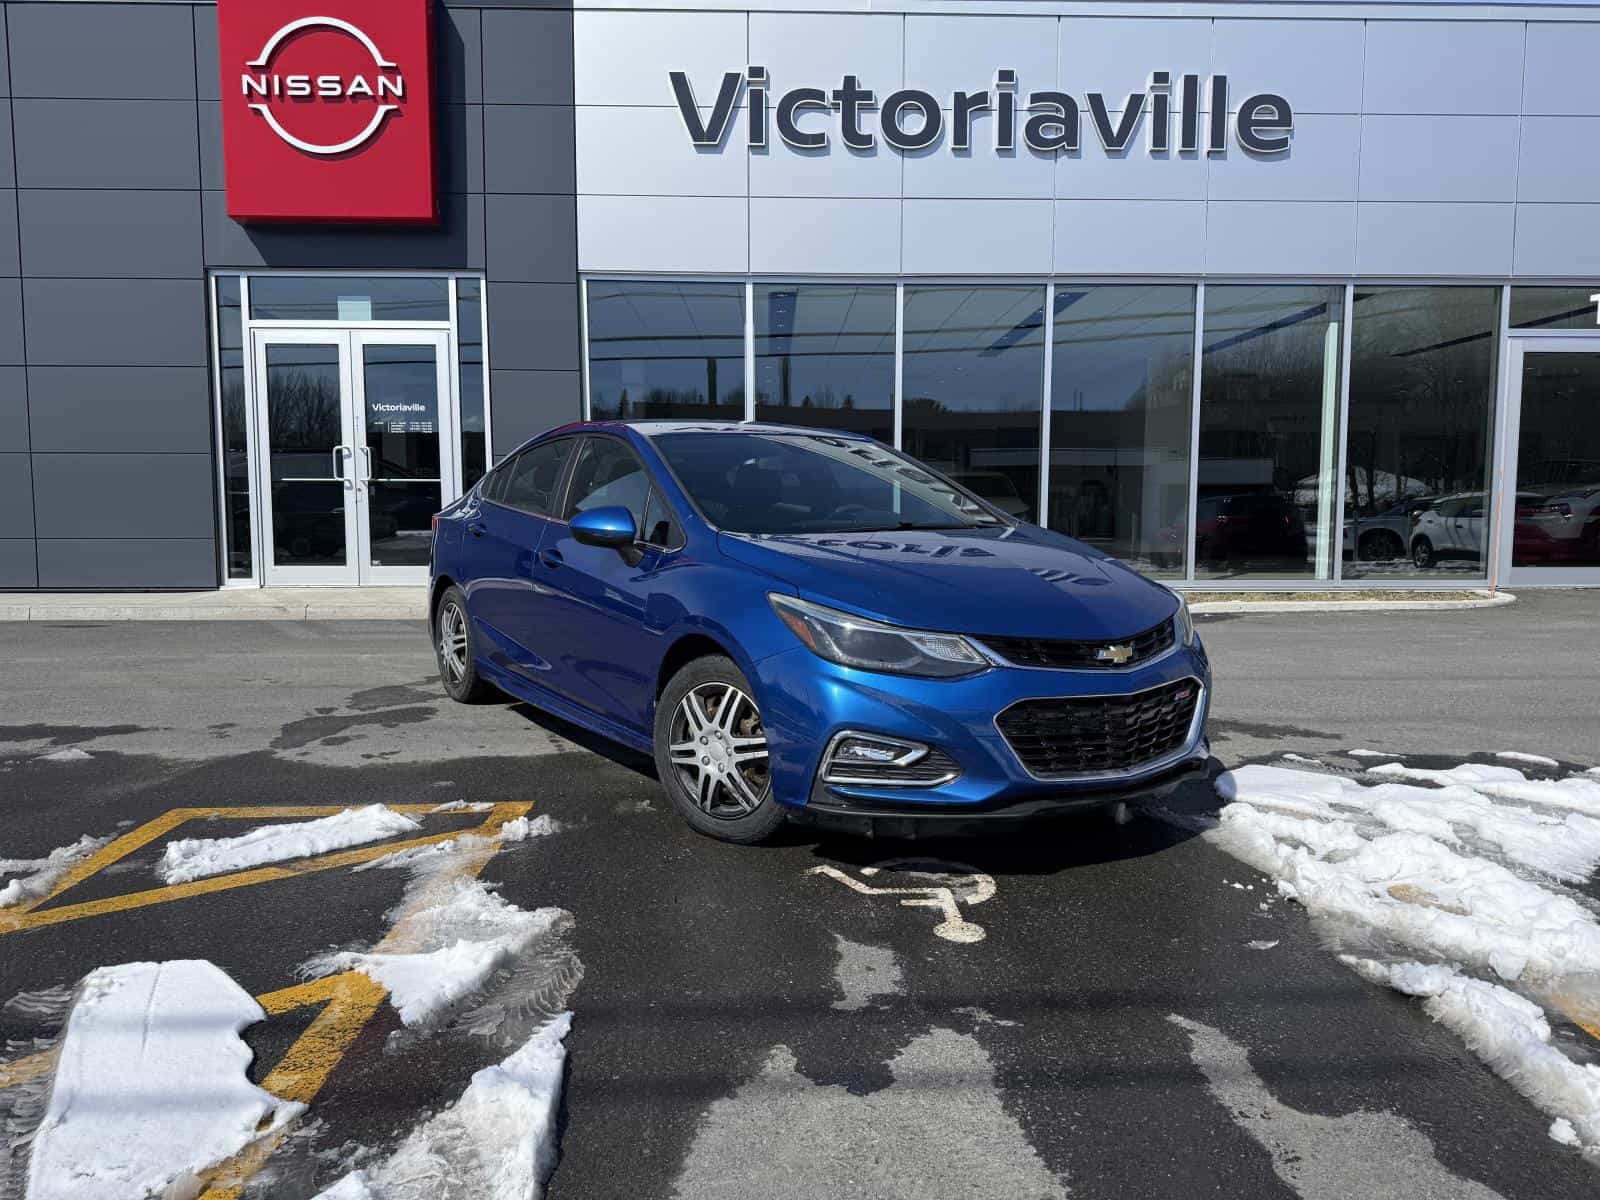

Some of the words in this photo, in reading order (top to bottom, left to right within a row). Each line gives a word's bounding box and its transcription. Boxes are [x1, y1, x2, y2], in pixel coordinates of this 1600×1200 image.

[241, 73, 404, 97] NISSAN
[668, 65, 1294, 154] Victoriaville
[371, 402, 426, 412] Victoriaville
